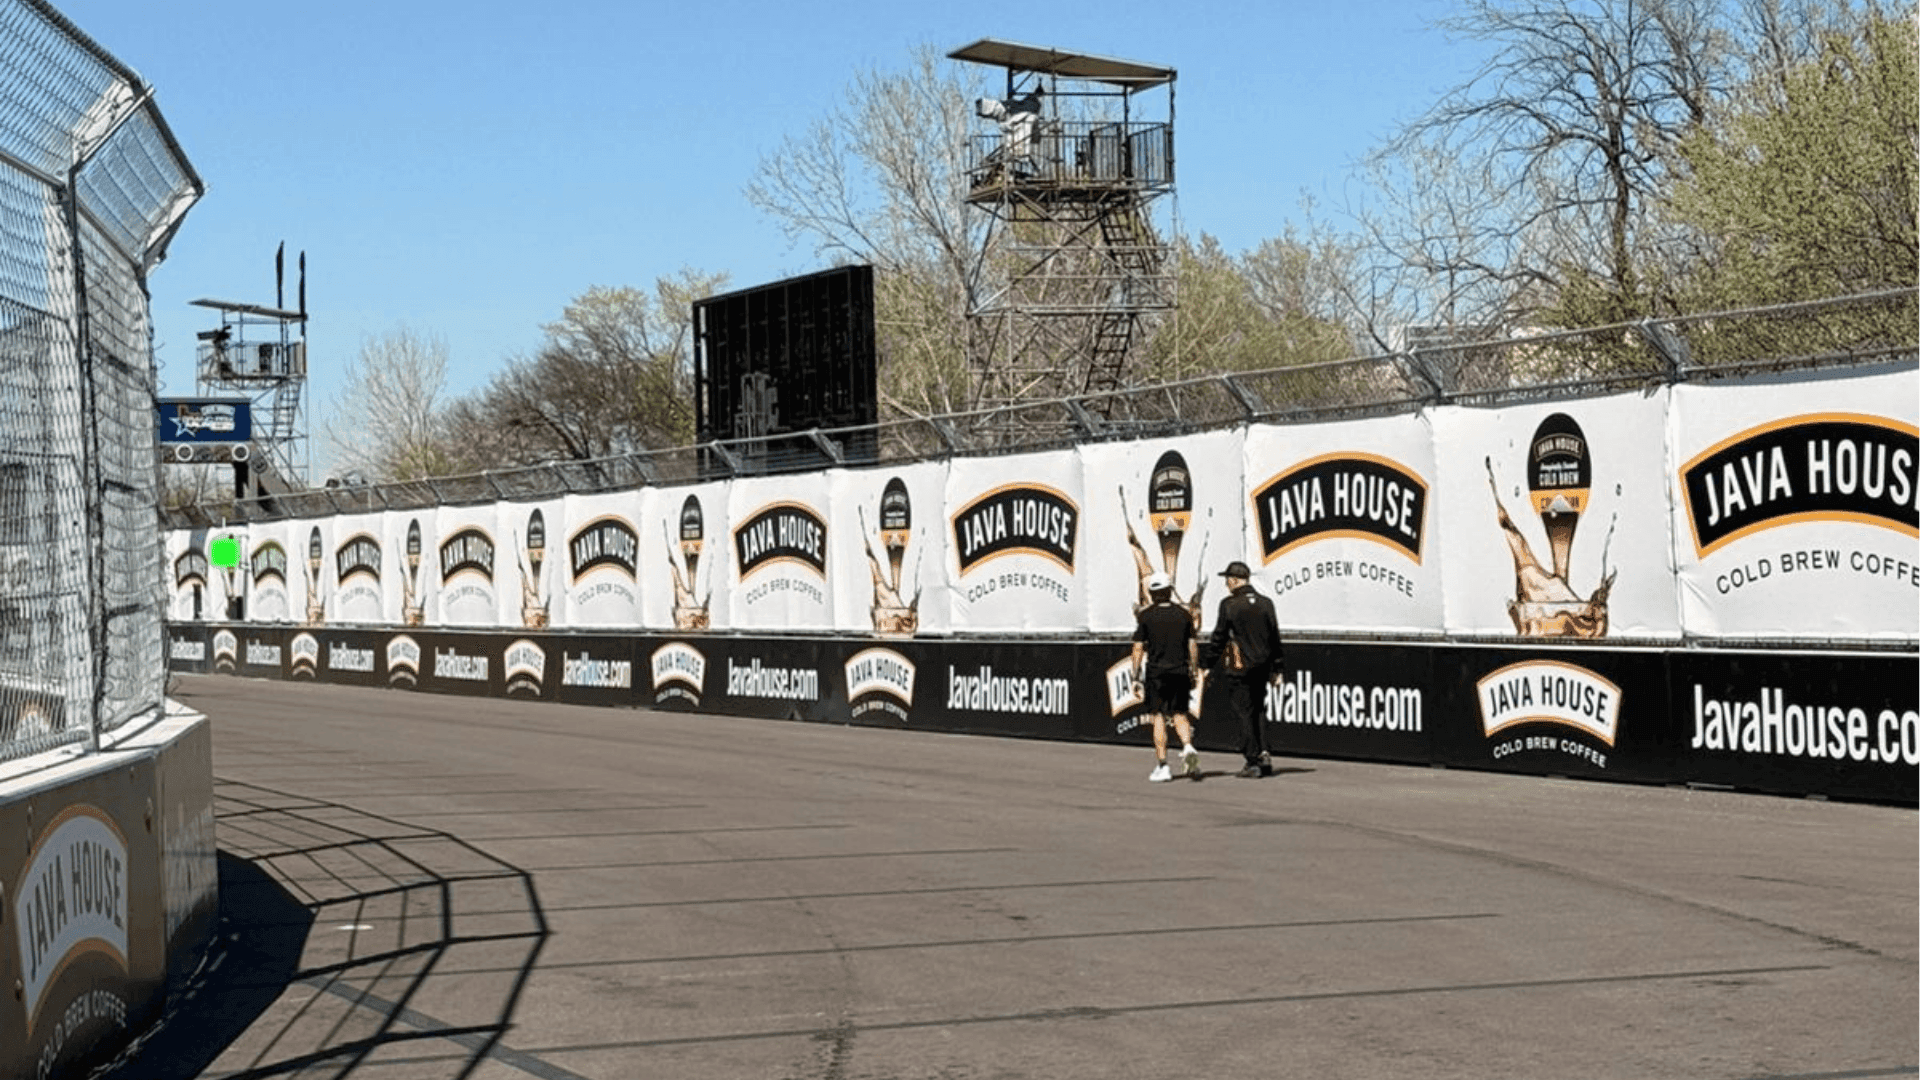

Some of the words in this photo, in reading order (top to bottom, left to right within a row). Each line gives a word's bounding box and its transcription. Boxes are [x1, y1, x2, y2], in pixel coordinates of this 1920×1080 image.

[1704, 446, 1793, 527] JAVA
[1807, 439, 1920, 512] HOUS
[963, 503, 1007, 557] JAVA
[1268, 476, 1325, 540] JAVA
[574, 529, 600, 571] JAVA
[603, 526, 636, 567] HOUSE
[742, 518, 775, 564] JAVA
[778, 515, 823, 563] HOUSE
[746, 583, 768, 605] COLD
[968, 578, 996, 603] COLD
[1000, 573, 1027, 589] BREW
[1031, 573, 1069, 603] COFFEE
[1274, 567, 1311, 595] COLD
[1316, 561, 1353, 579] BREW
[1359, 562, 1414, 598] COFFEE
[1716, 558, 1772, 594] COLD
[1780, 550, 1840, 573] BREW
[726, 657, 819, 701] JavaHouse.com
[851, 659, 872, 689] JAVA
[876, 657, 909, 692] HOUSE
[947, 664, 1069, 715] JavaHouse.com
[1263, 670, 1422, 732] avaHouse.com
[1490, 676, 1533, 718] JAVA
[1117, 716, 1138, 734] COLD
[1691, 683, 1920, 766] JavaHouse.co
[1493, 738, 1523, 759] COLD
[1525, 736, 1558, 750] BREW
[1560, 738, 1607, 768] COFFEE
[26, 854, 67, 984] JAVA
[70, 840, 125, 932] HOUSE
